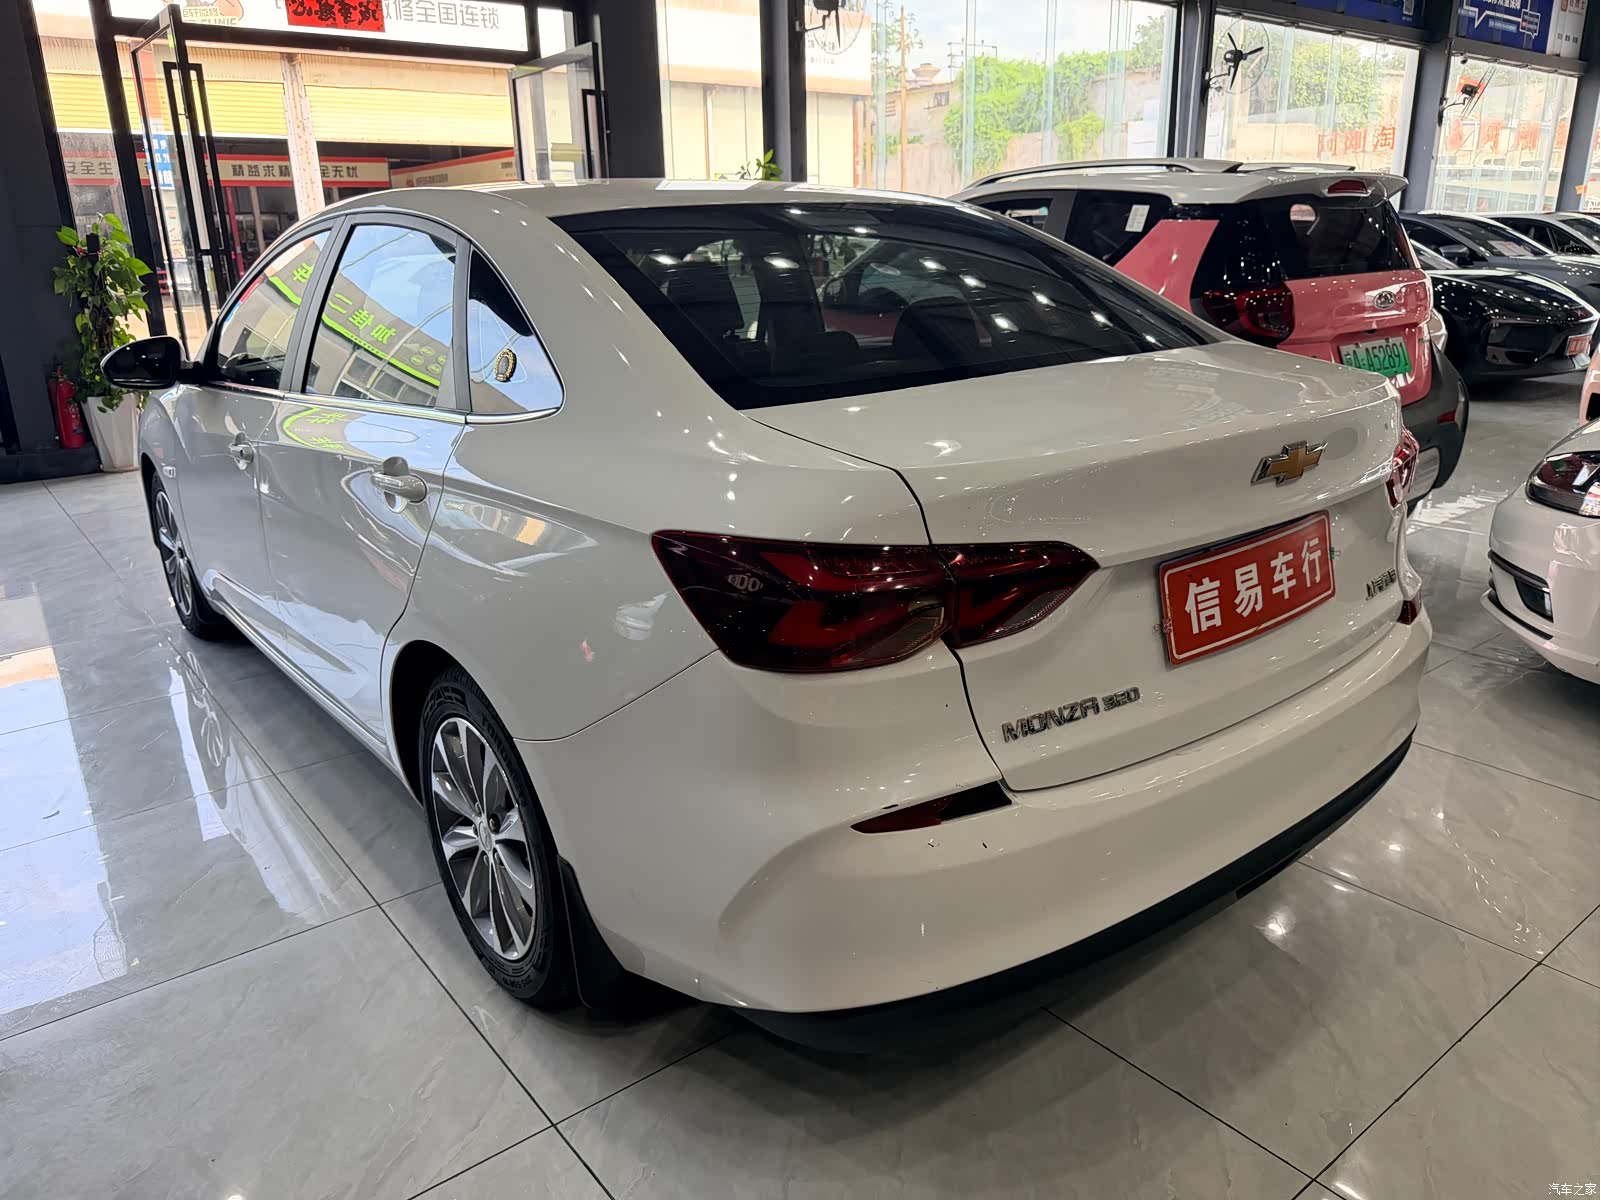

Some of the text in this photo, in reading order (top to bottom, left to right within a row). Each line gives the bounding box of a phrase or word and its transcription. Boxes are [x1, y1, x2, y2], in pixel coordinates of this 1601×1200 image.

[231, 164, 359, 179] 精益求精 全无忧
[1185, 537, 1322, 634] 信易车行
[1001, 686, 1141, 743] MONZA 320
